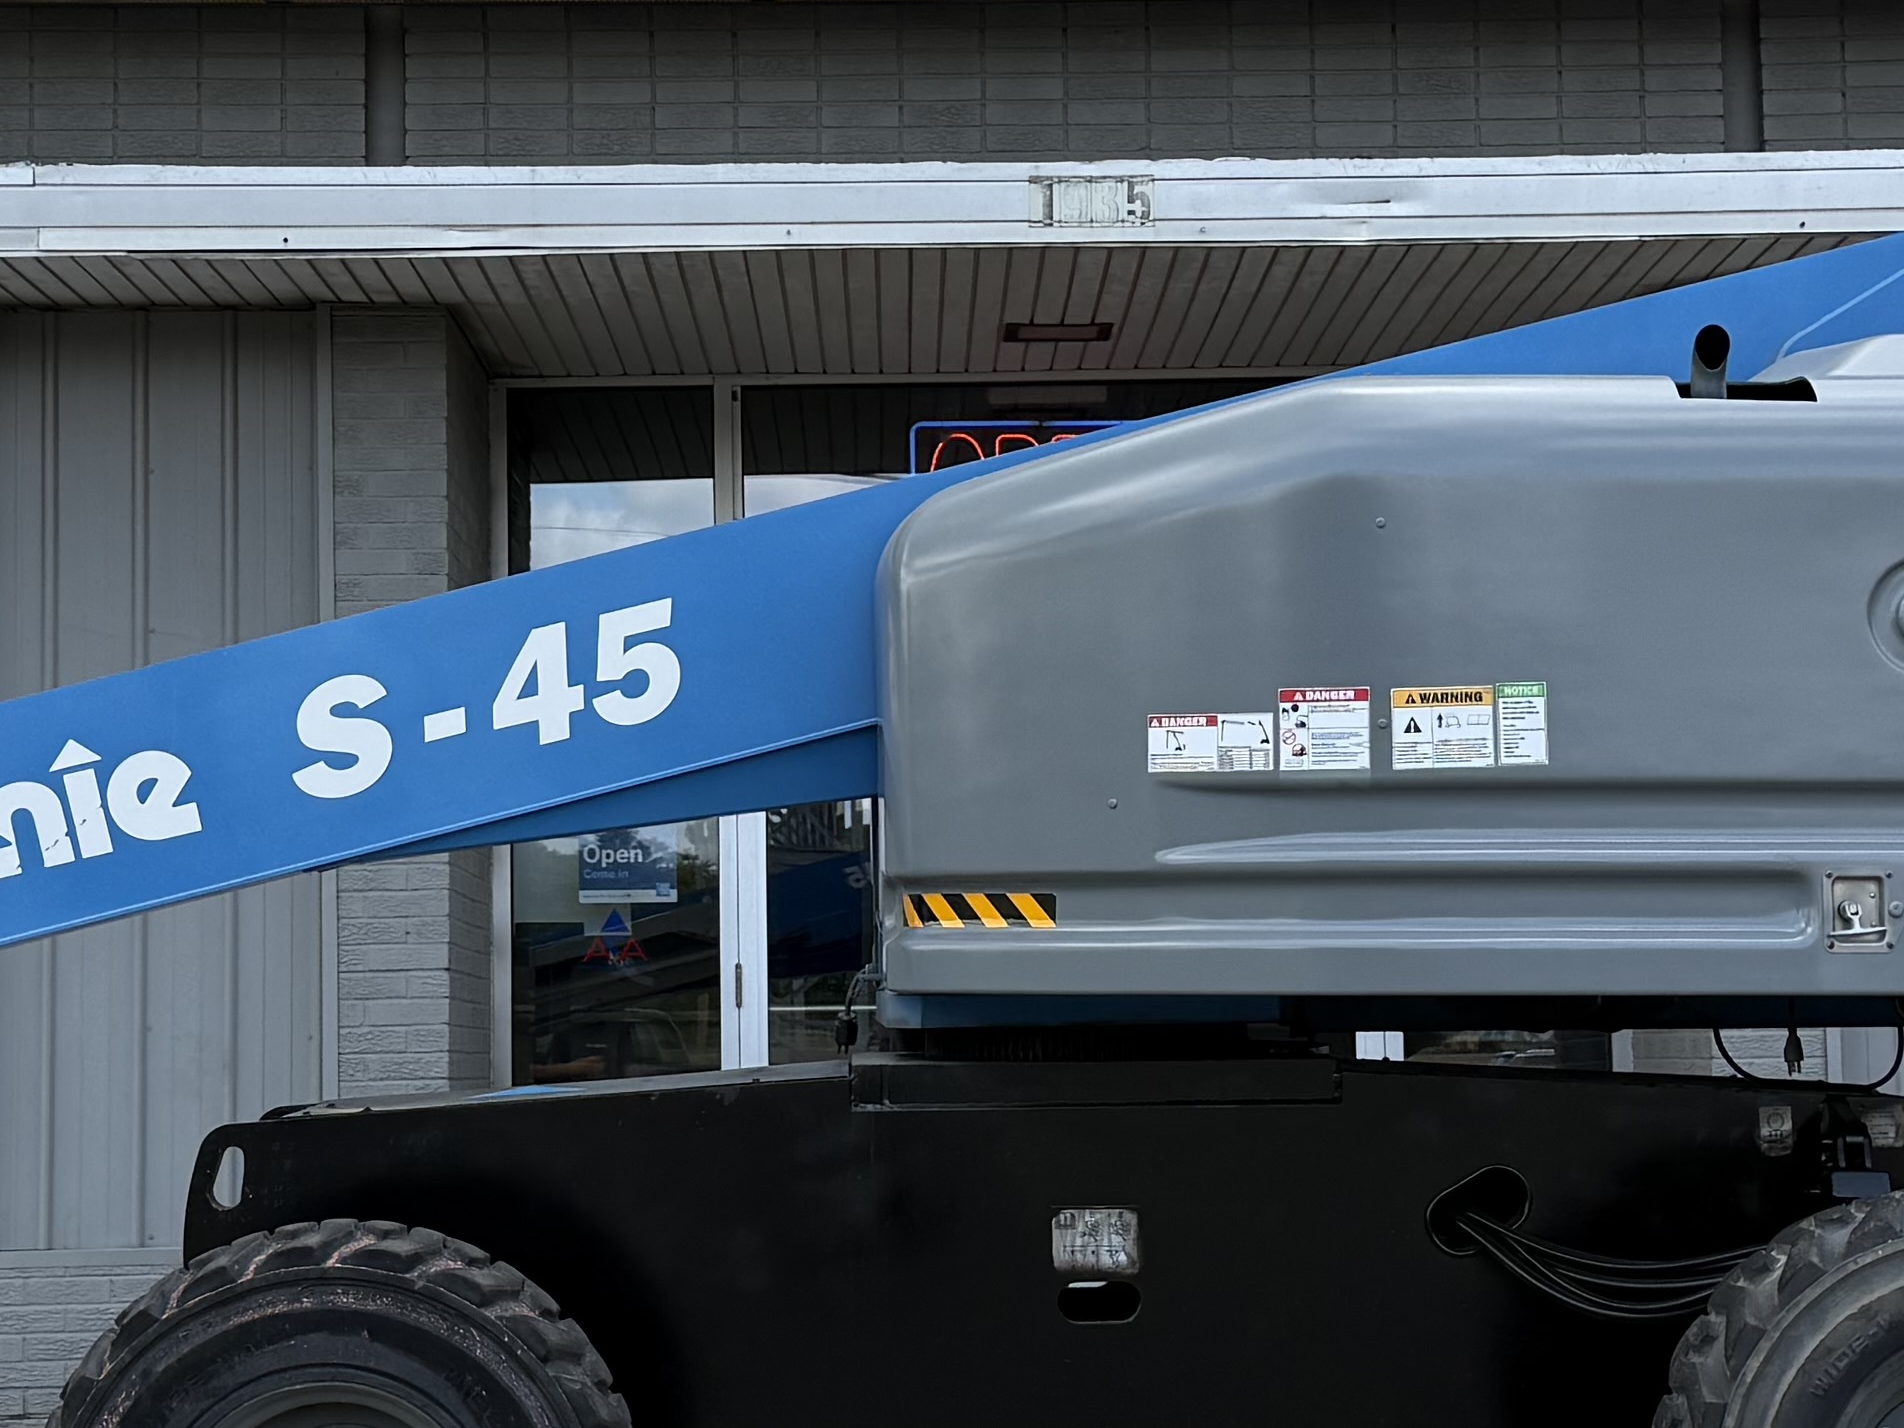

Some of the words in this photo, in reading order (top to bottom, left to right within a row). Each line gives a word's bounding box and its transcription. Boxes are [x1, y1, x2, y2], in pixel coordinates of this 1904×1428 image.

[1304, 690, 1355, 701] DANGER
[1503, 686, 1539, 697] NOTICE
[1418, 692, 1483, 704] WARNING
[1161, 717, 1206, 727] DANGER
[583, 844, 643, 868] Open
